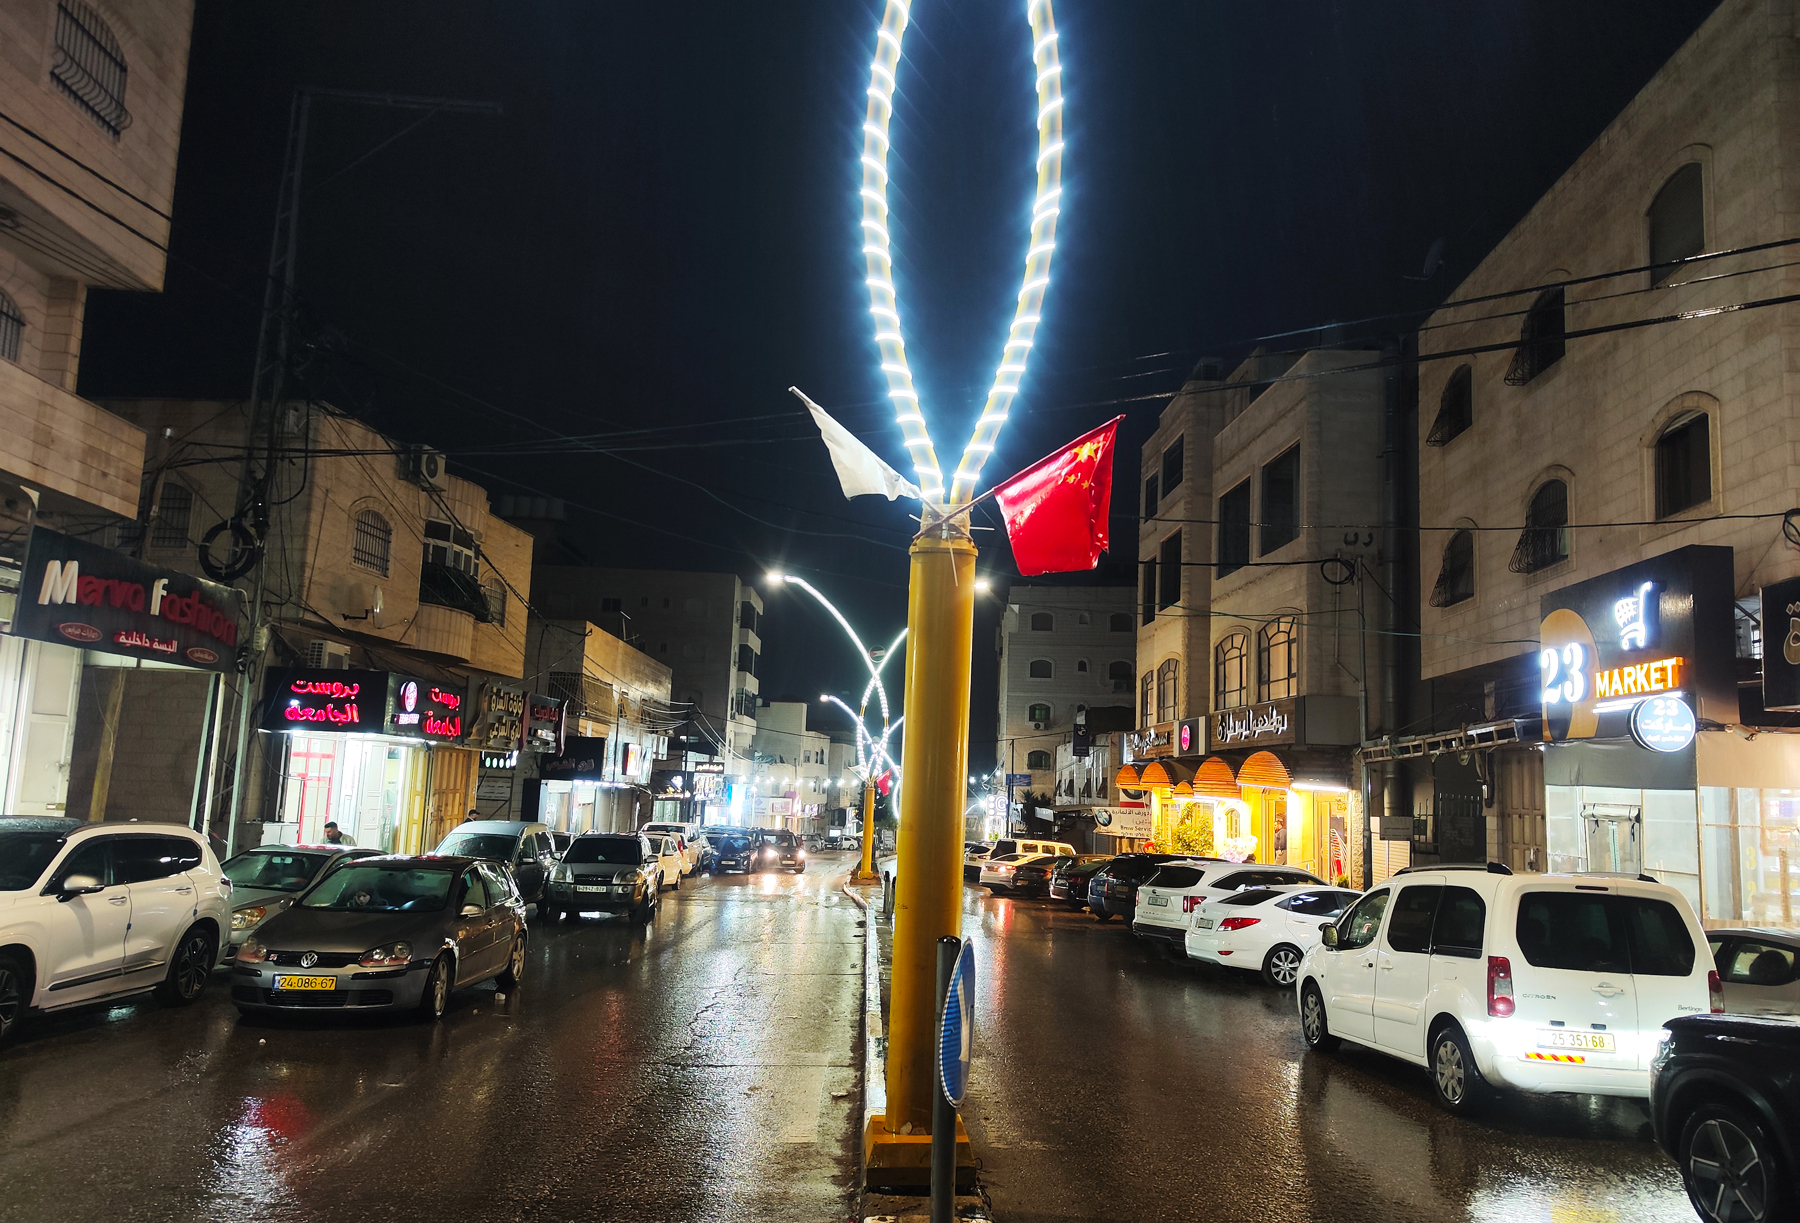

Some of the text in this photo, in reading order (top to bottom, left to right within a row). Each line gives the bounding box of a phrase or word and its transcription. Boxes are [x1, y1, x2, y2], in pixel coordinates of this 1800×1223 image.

[38, 559, 238, 648] Merva fashion
[118, 630, 151, 649] داخلية
[1540, 642, 1679, 704] 23 MARKET
[290, 679, 360, 700] بروست
[430, 687, 461, 711] بروست
[284, 699, 360, 727] الجامعة
[1653, 699, 1679, 716] 23
[424, 710, 461, 740] الجامعة
[1677, 1004, 1704, 1013] Berlingo
